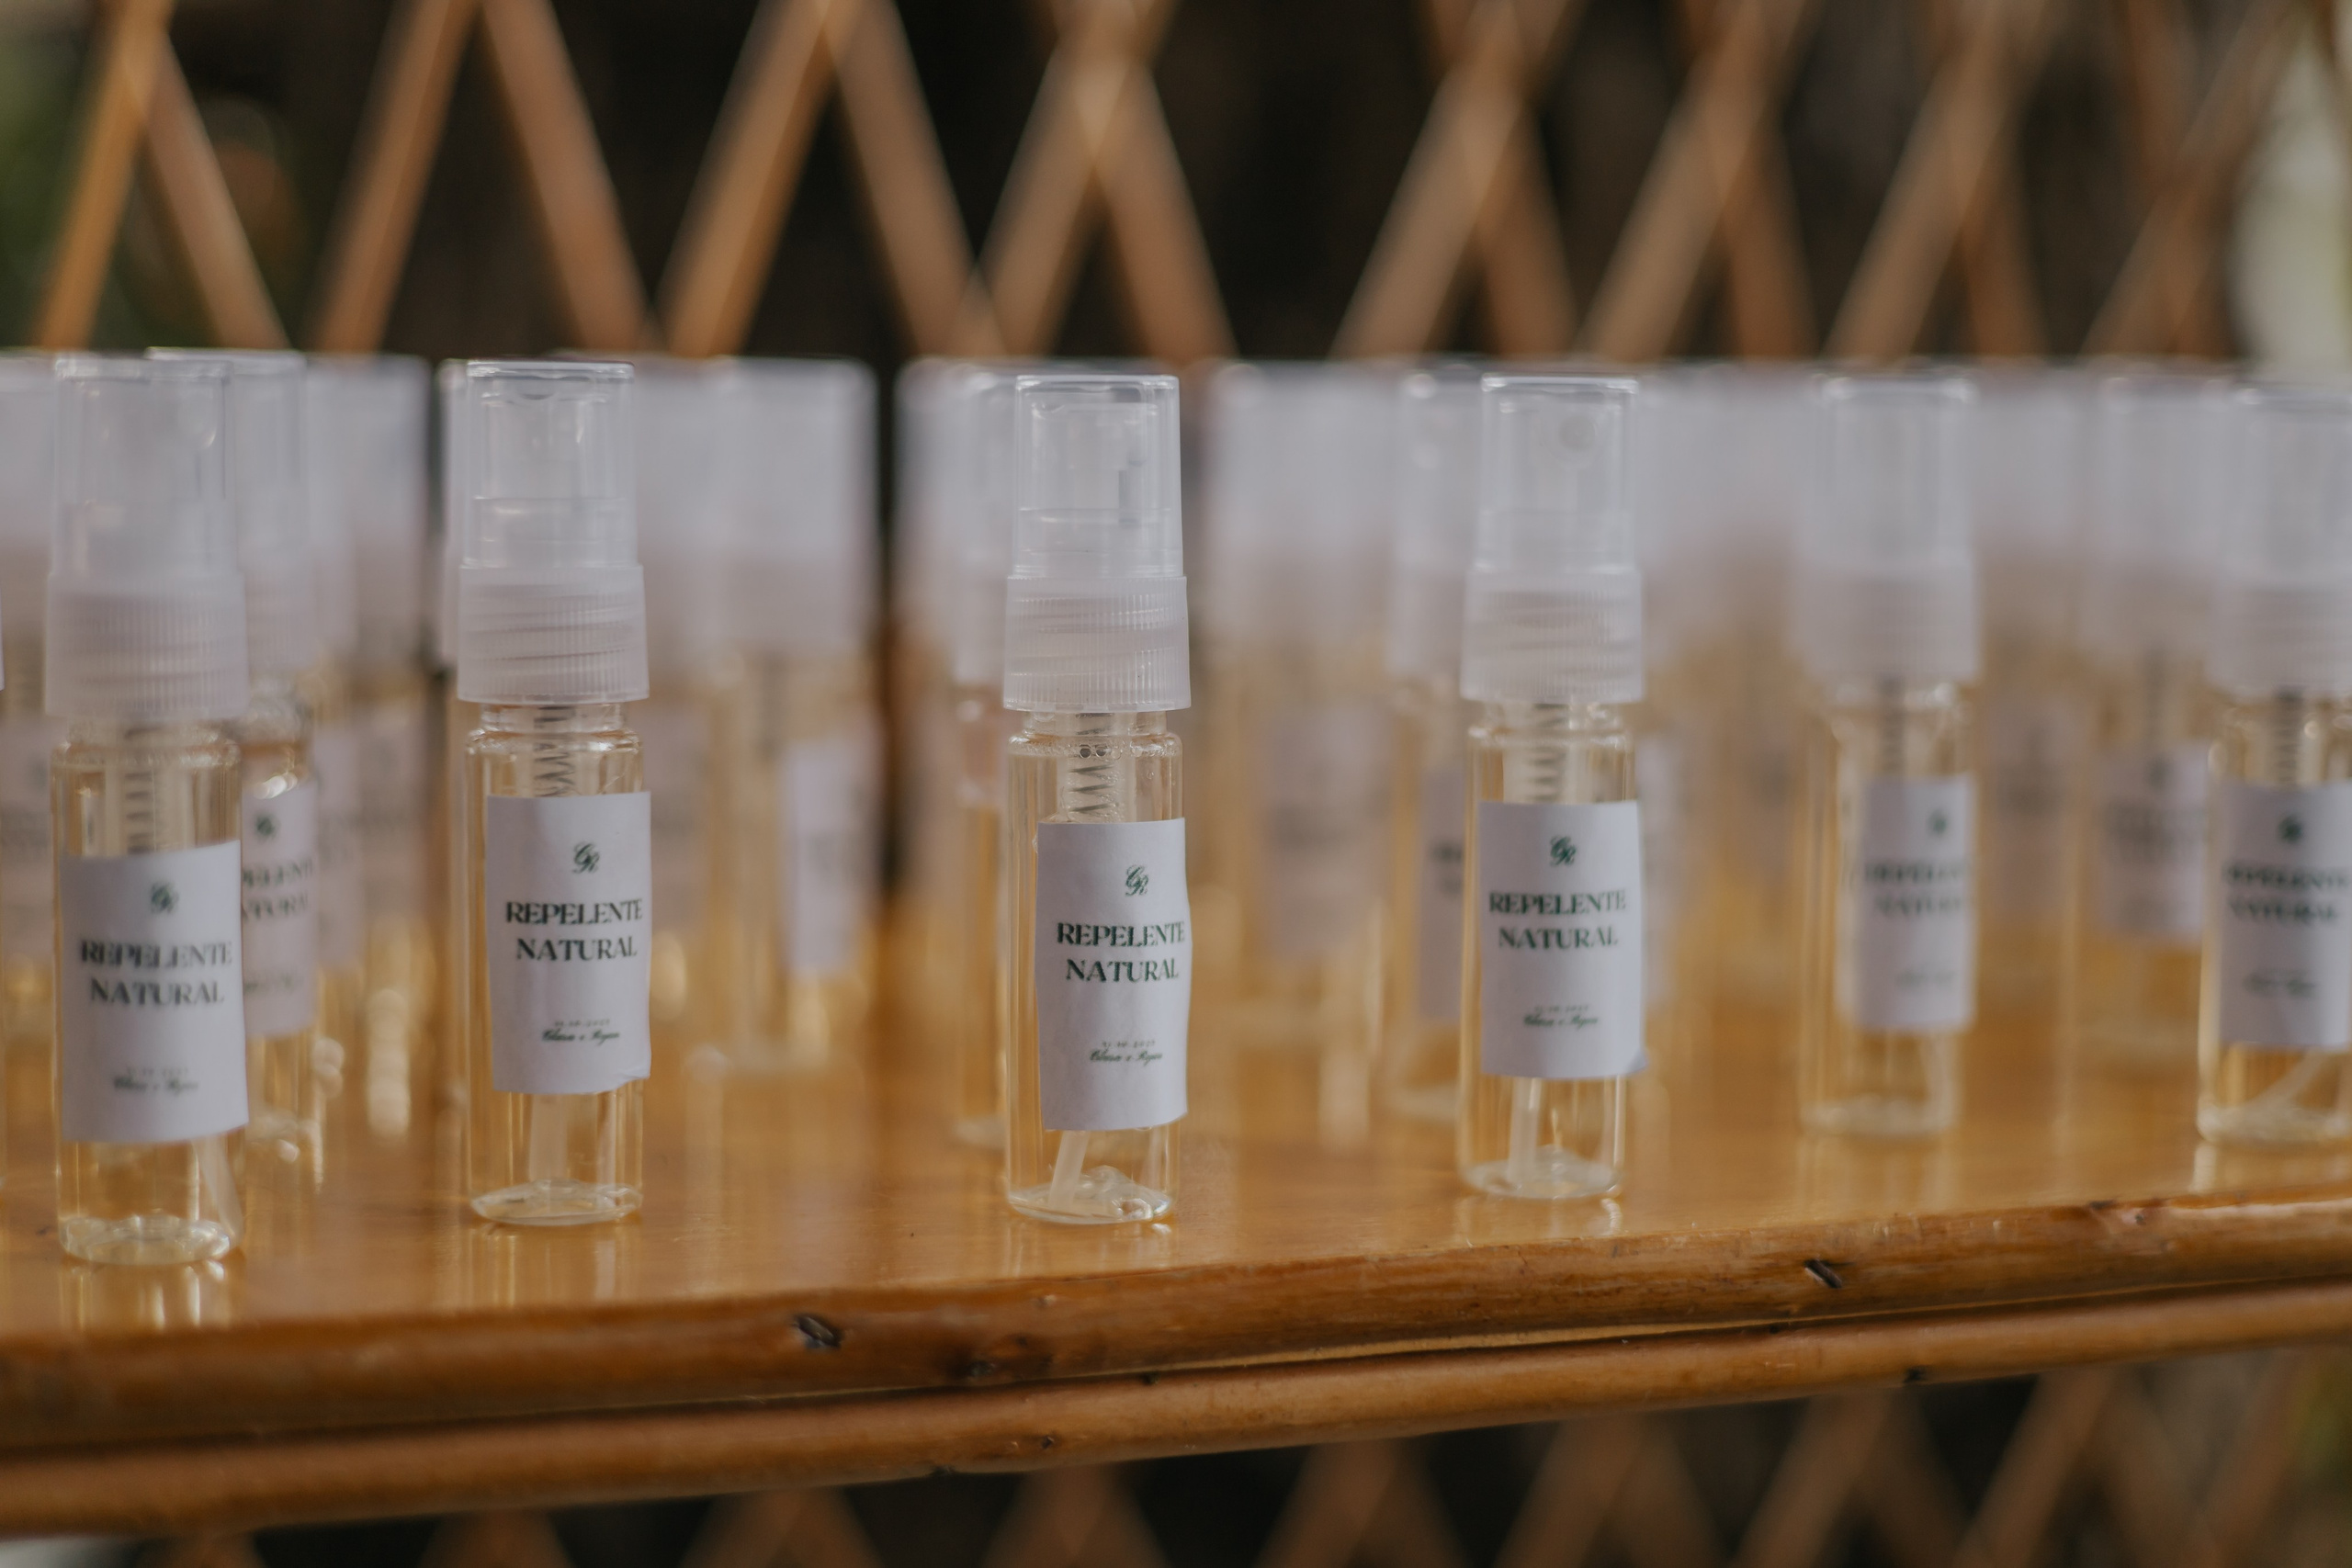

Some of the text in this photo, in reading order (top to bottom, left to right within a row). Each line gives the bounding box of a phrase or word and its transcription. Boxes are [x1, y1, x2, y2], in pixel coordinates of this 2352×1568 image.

[506, 898, 643, 925] REPELENTE
[1488, 889, 1626, 915] REPELENTE
[1057, 921, 1186, 947] REPELENTE
[1498, 925, 1618, 950] NATURAL
[81, 940, 232, 968] REPELENTE
[516, 936, 638, 962] NATURAL
[1066, 958, 1179, 983] NATURAL
[90, 977, 224, 1006] NATURAL
